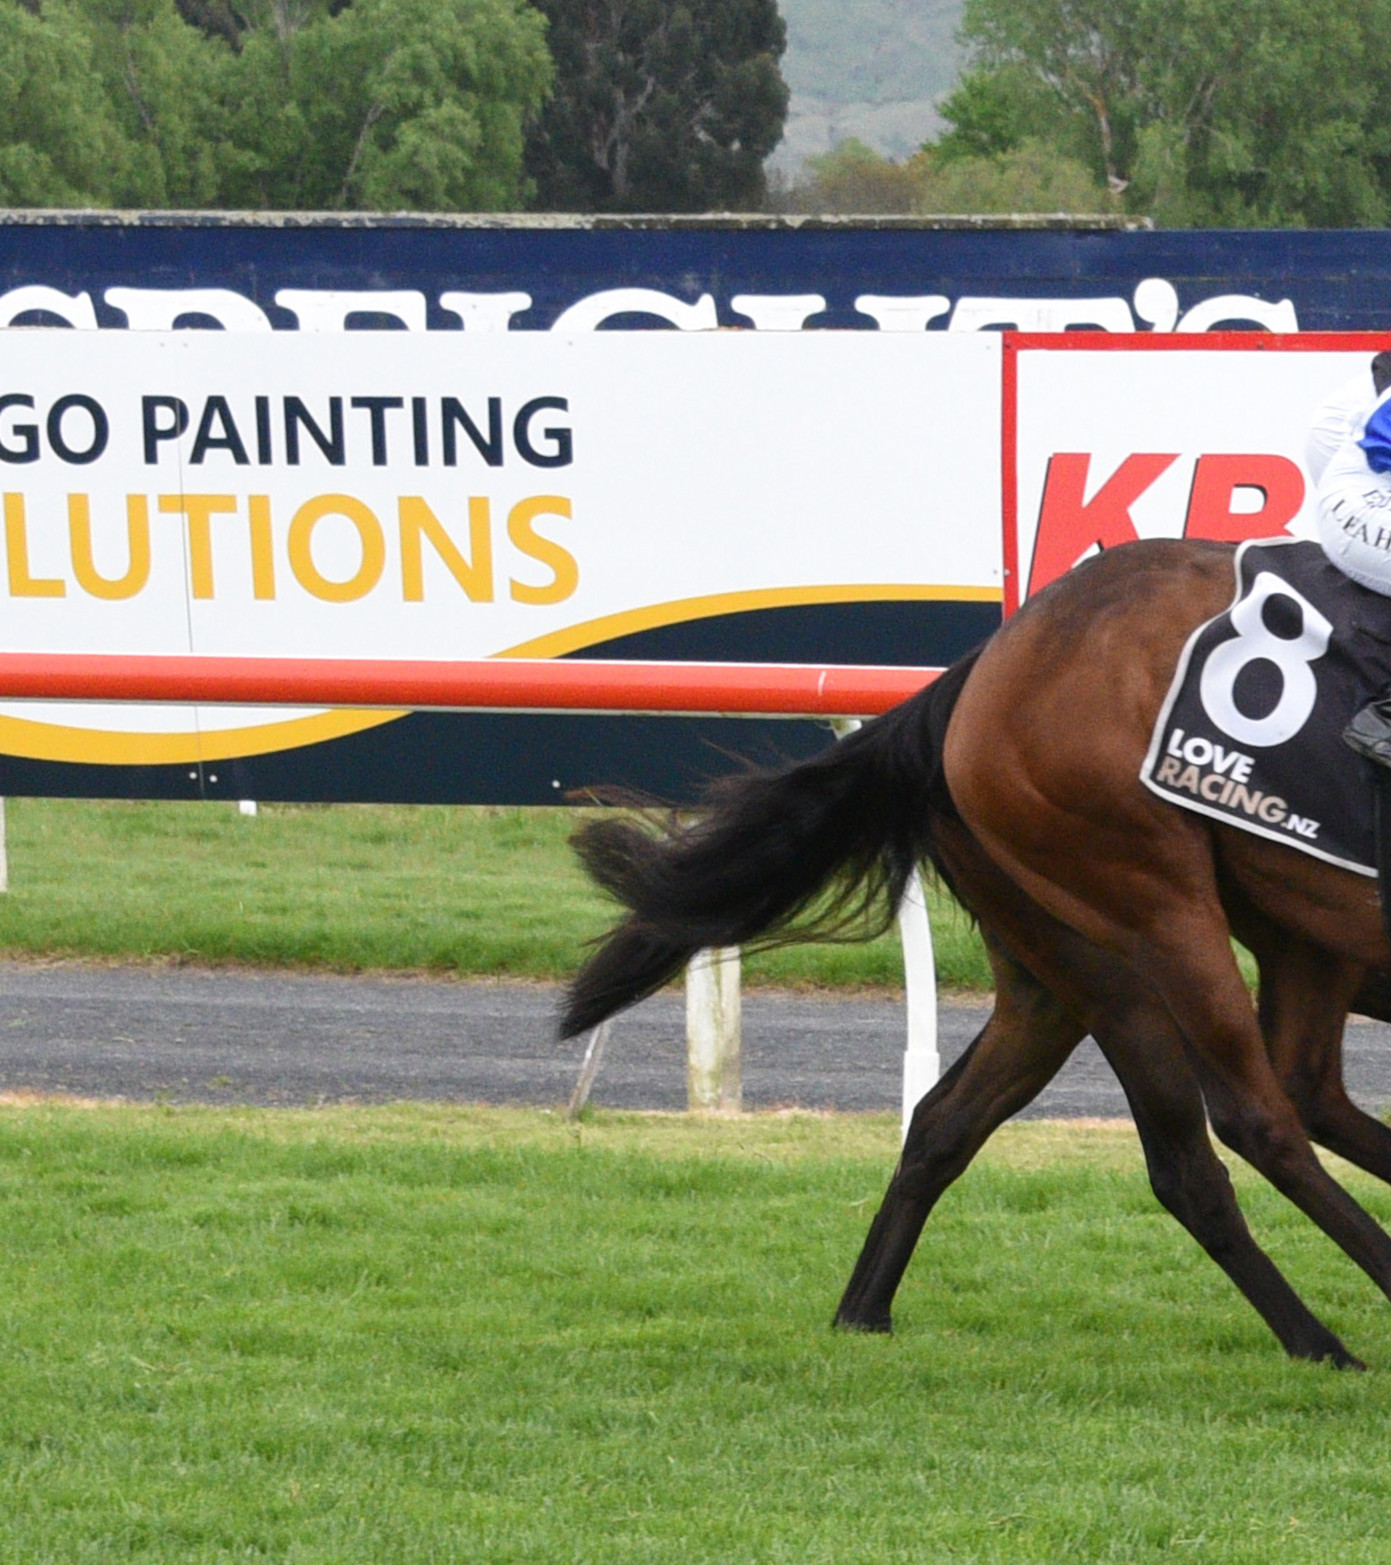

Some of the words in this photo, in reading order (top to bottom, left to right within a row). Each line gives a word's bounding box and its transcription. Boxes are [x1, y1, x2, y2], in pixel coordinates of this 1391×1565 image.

[141, 395, 573, 468] PAINTING
[3, 492, 579, 605] LUTIONS
[1200, 571, 1334, 747] 8
[1167, 728, 1256, 783] LOVE
